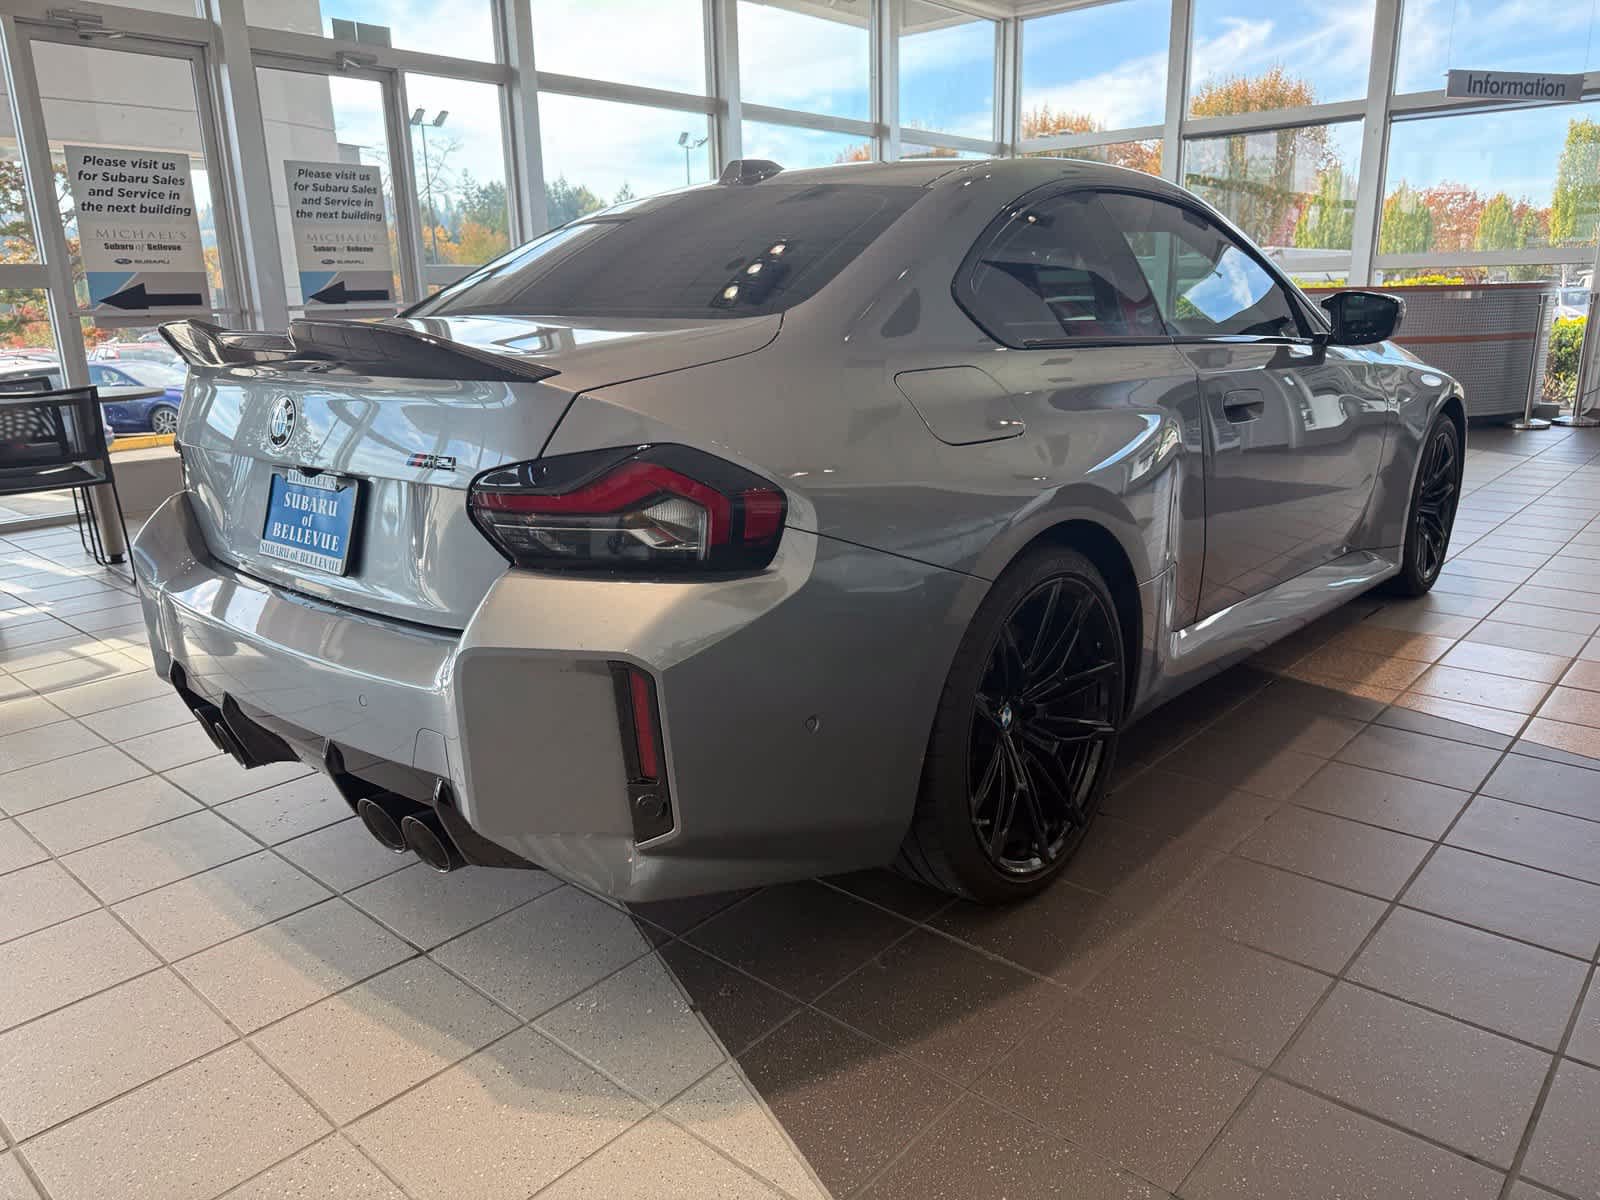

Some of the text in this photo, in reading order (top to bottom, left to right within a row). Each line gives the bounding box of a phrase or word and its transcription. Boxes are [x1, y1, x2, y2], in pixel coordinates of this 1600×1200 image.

[1467, 73, 1566, 97] Information
[82, 155, 176, 171] Please visit us
[78, 170, 185, 186] for Subaru Sales
[297, 168, 371, 181] Please visit us
[88, 187, 180, 200] and Service in
[294, 182, 377, 194] for Subaru Sales
[301, 196, 373, 207] and Service in
[81, 201, 192, 217] the next building
[296, 209, 382, 222] the next building
[96, 229, 187, 240] MICHAEL'S
[104, 242, 182, 252] Subaru of Bellevue
[283, 491, 338, 517] SUBARU
[302, 513, 313, 527] of
[272, 521, 340, 552] BELLEVUE
[260, 543, 289, 560] SUBARU
[300, 550, 341, 573] BELLEVUE
